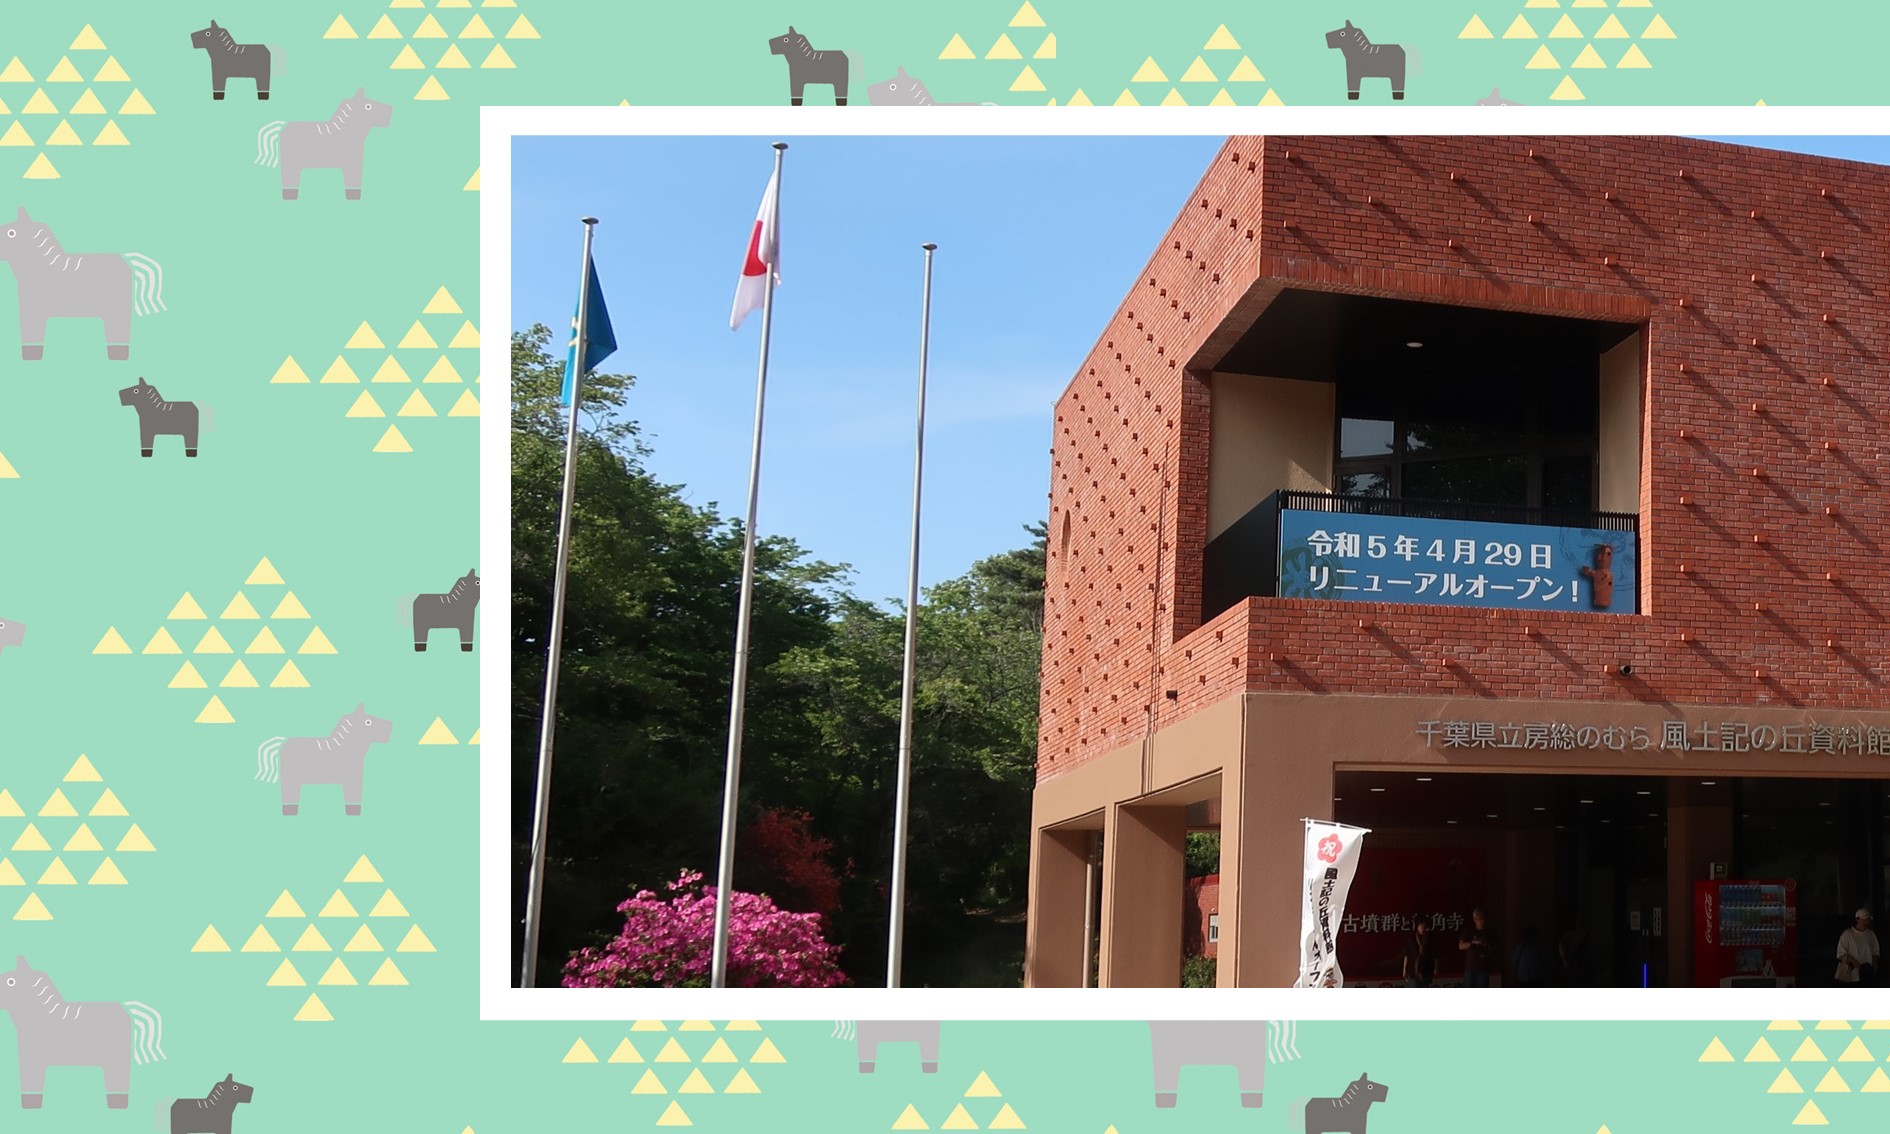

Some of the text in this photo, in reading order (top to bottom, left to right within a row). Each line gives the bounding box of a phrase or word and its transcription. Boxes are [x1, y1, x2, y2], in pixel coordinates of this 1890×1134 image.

[1307, 529, 1552, 569] 令和5年4月29日
[1309, 566, 1579, 603] リニューアルオープン！
[1415, 719, 1651, 751] 千葉県立房総のむら
[1320, 840, 1337, 857] 祝
[1342, 912, 1464, 934] 古墳群と角寺
